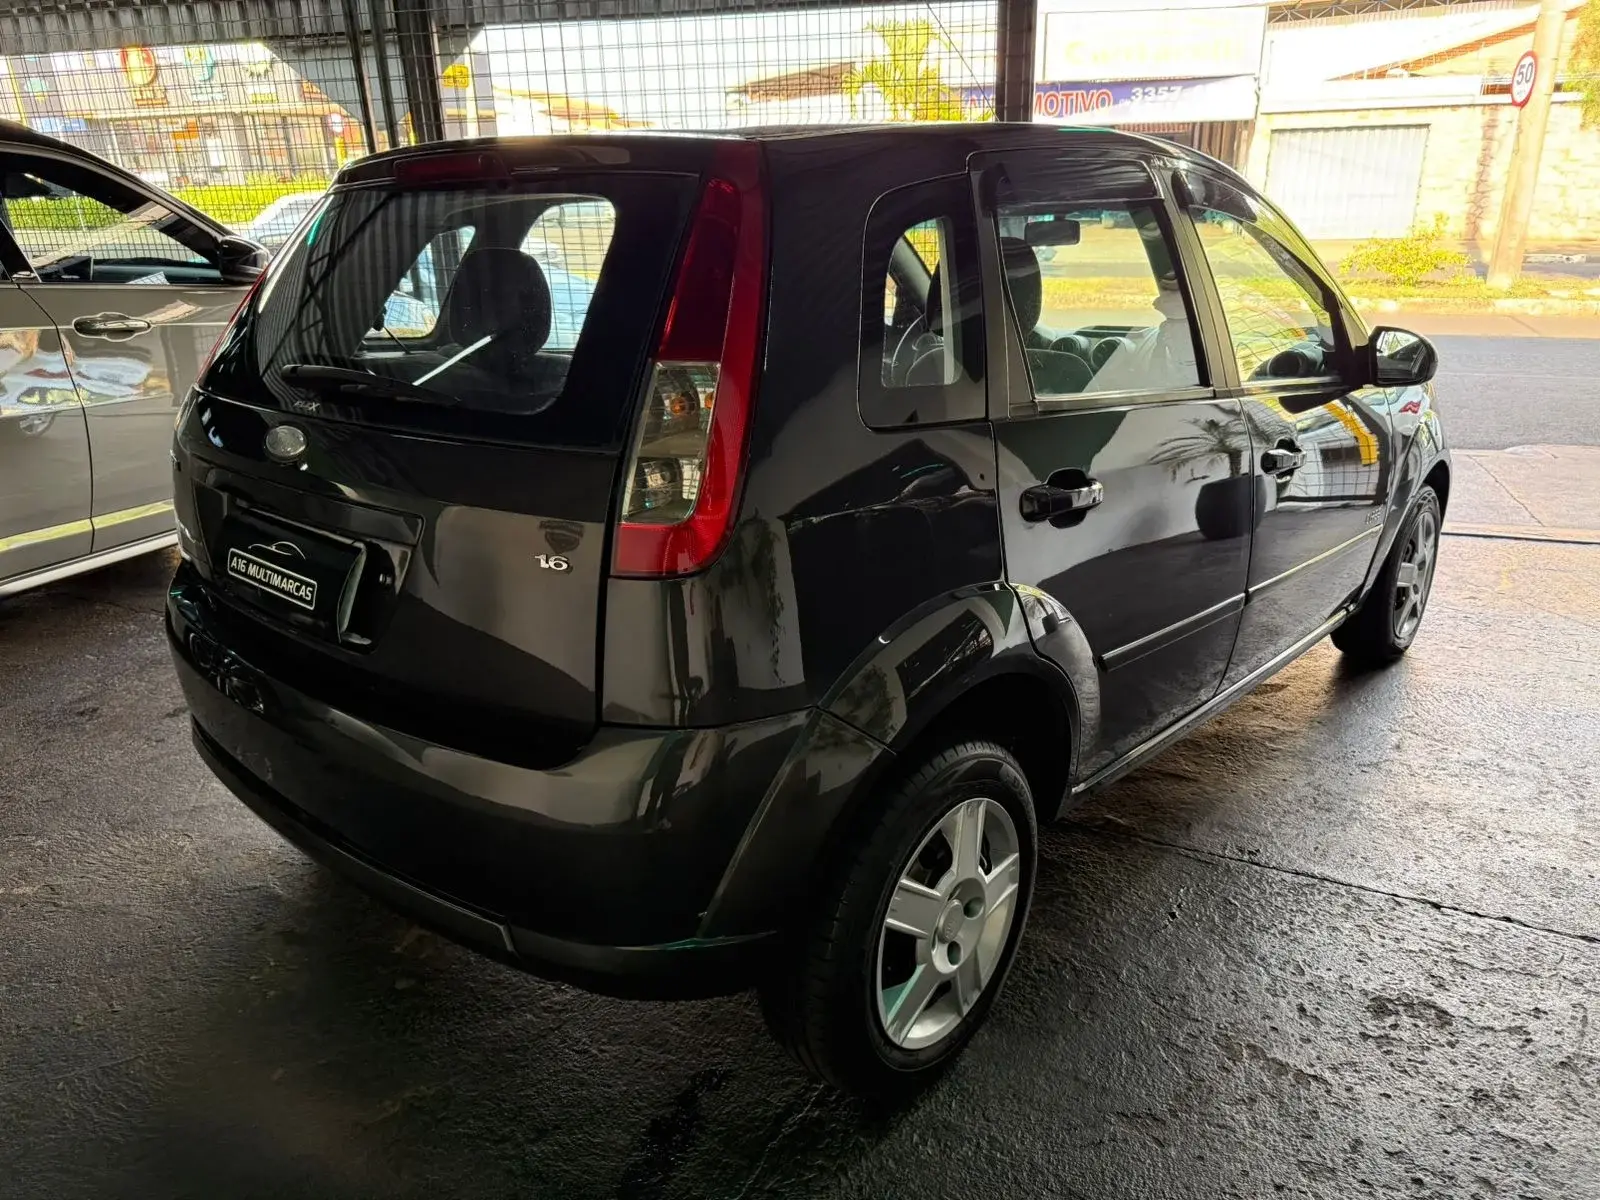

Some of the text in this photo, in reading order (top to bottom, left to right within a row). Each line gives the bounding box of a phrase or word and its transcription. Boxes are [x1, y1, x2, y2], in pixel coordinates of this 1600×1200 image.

[1516, 61, 1534, 85] 50
[230, 556, 313, 601] A16 MULTIMARCAS
